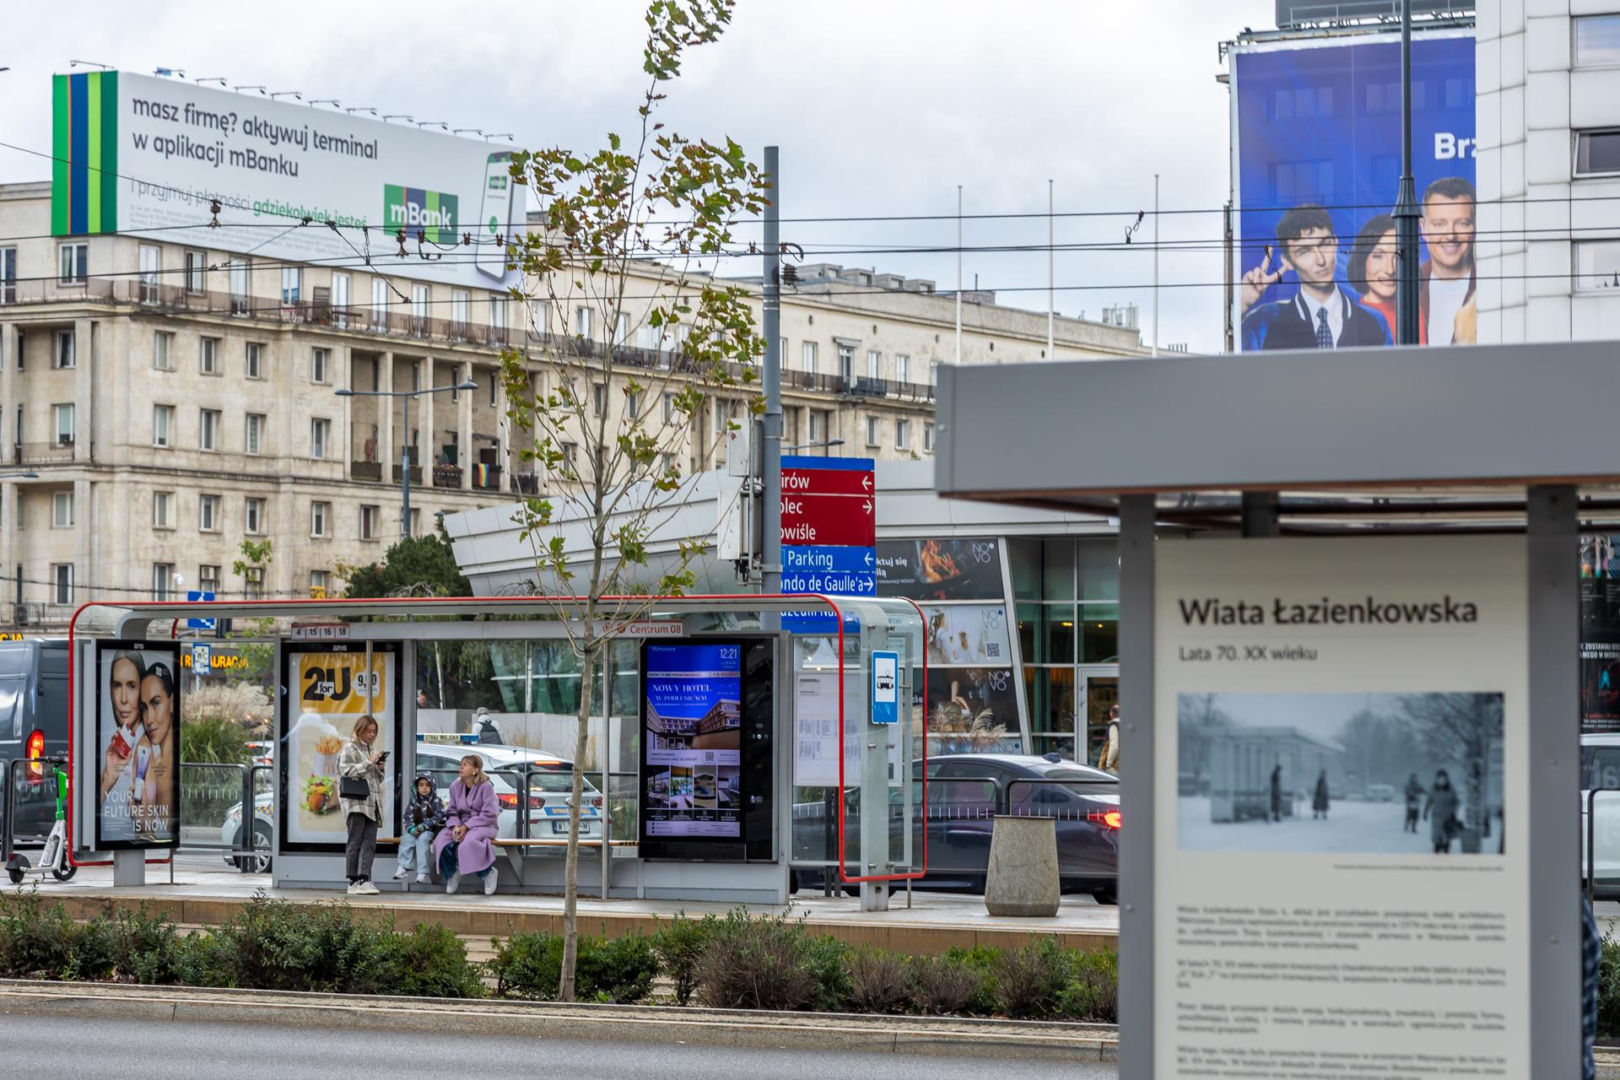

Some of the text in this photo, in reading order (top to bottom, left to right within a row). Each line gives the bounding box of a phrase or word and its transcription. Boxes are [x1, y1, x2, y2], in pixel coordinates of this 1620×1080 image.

[132, 98, 378, 160] masz firmę? aktywuj terminal
[132, 132, 299, 177] w aplikacji mBanku
[390, 201, 452, 231] mBank
[788, 550, 833, 570] Parking
[808, 574, 822, 591] de
[824, 575, 863, 592] Gaulle'a
[1178, 595, 1479, 626] Wiata Łazienkowska
[310, 627, 317, 635] 15
[324, 628, 332, 636] 16
[630, 624, 681, 634] Centrum 08
[720, 648, 737, 659] 12:21
[1179, 645, 1212, 662] Lata
[1245, 645, 1267, 661] XX
[1271, 645, 1318, 661] wieku
[105, 791, 133, 802] YOUR
[104, 805, 168, 817] FUTURE SKIN
[132, 820, 142, 832] IS
[144, 819, 168, 831] NOW
